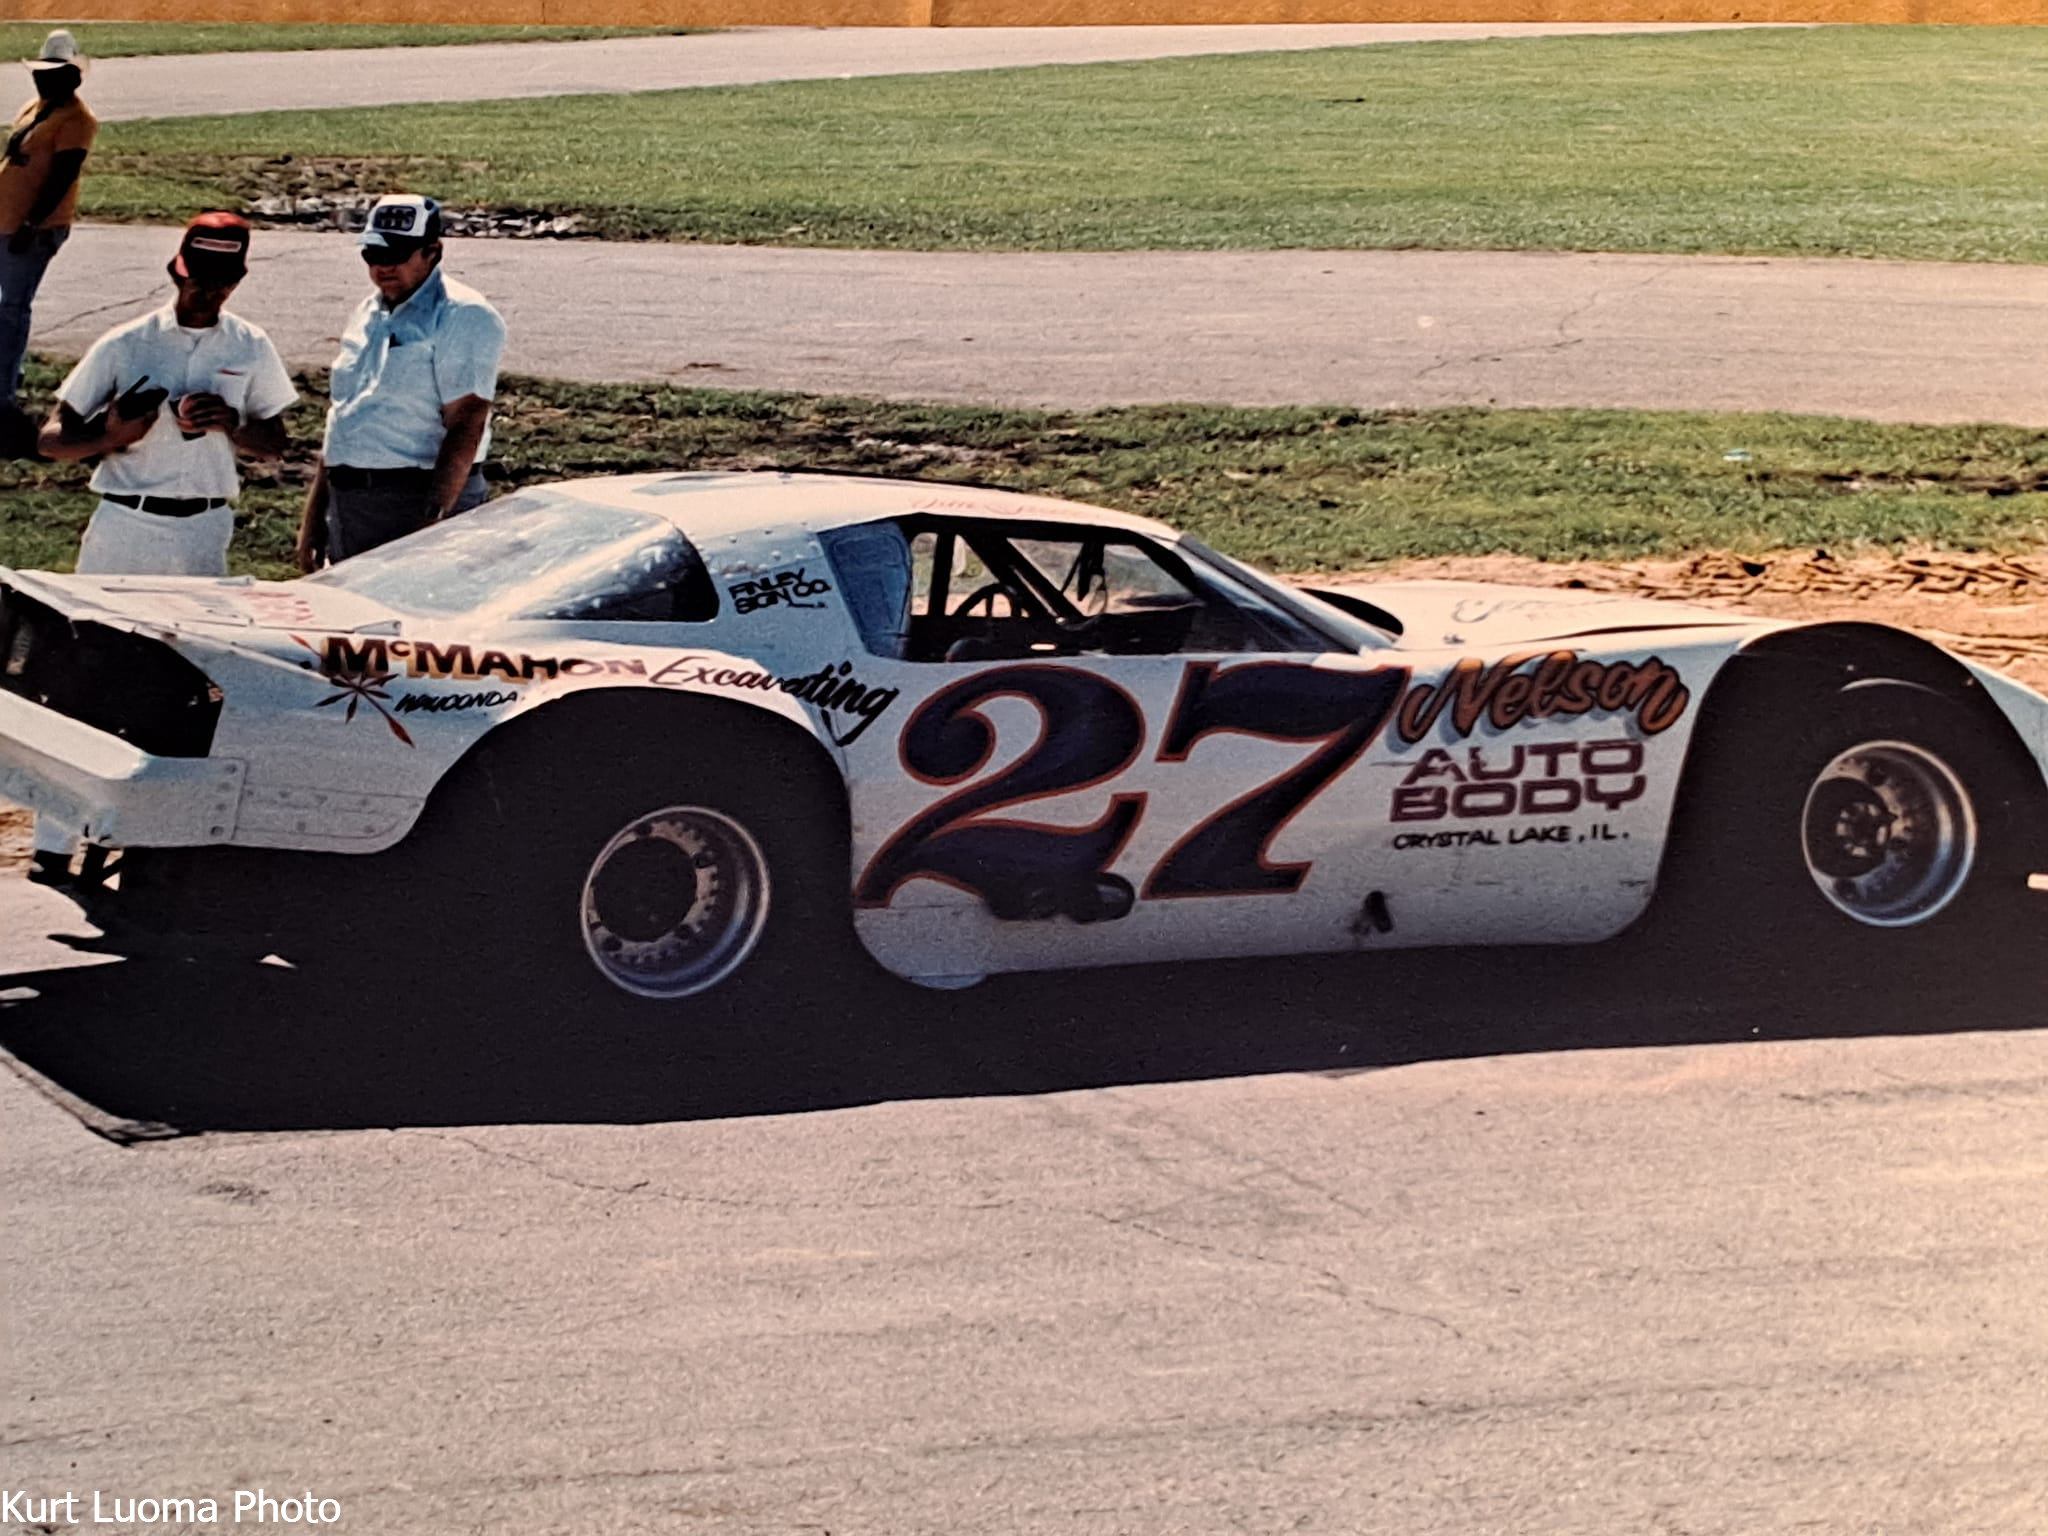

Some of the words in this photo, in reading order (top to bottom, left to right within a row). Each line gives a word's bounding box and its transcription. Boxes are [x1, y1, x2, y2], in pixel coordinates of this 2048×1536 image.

[649, 655, 900, 748] Excavating
[1397, 650, 1690, 744] Nelson
[853, 661, 1412, 909] 27
[1400, 738, 1644, 785] AUTO
[1389, 774, 1647, 822] BODY
[1393, 829, 1501, 850] CRYSTAL
